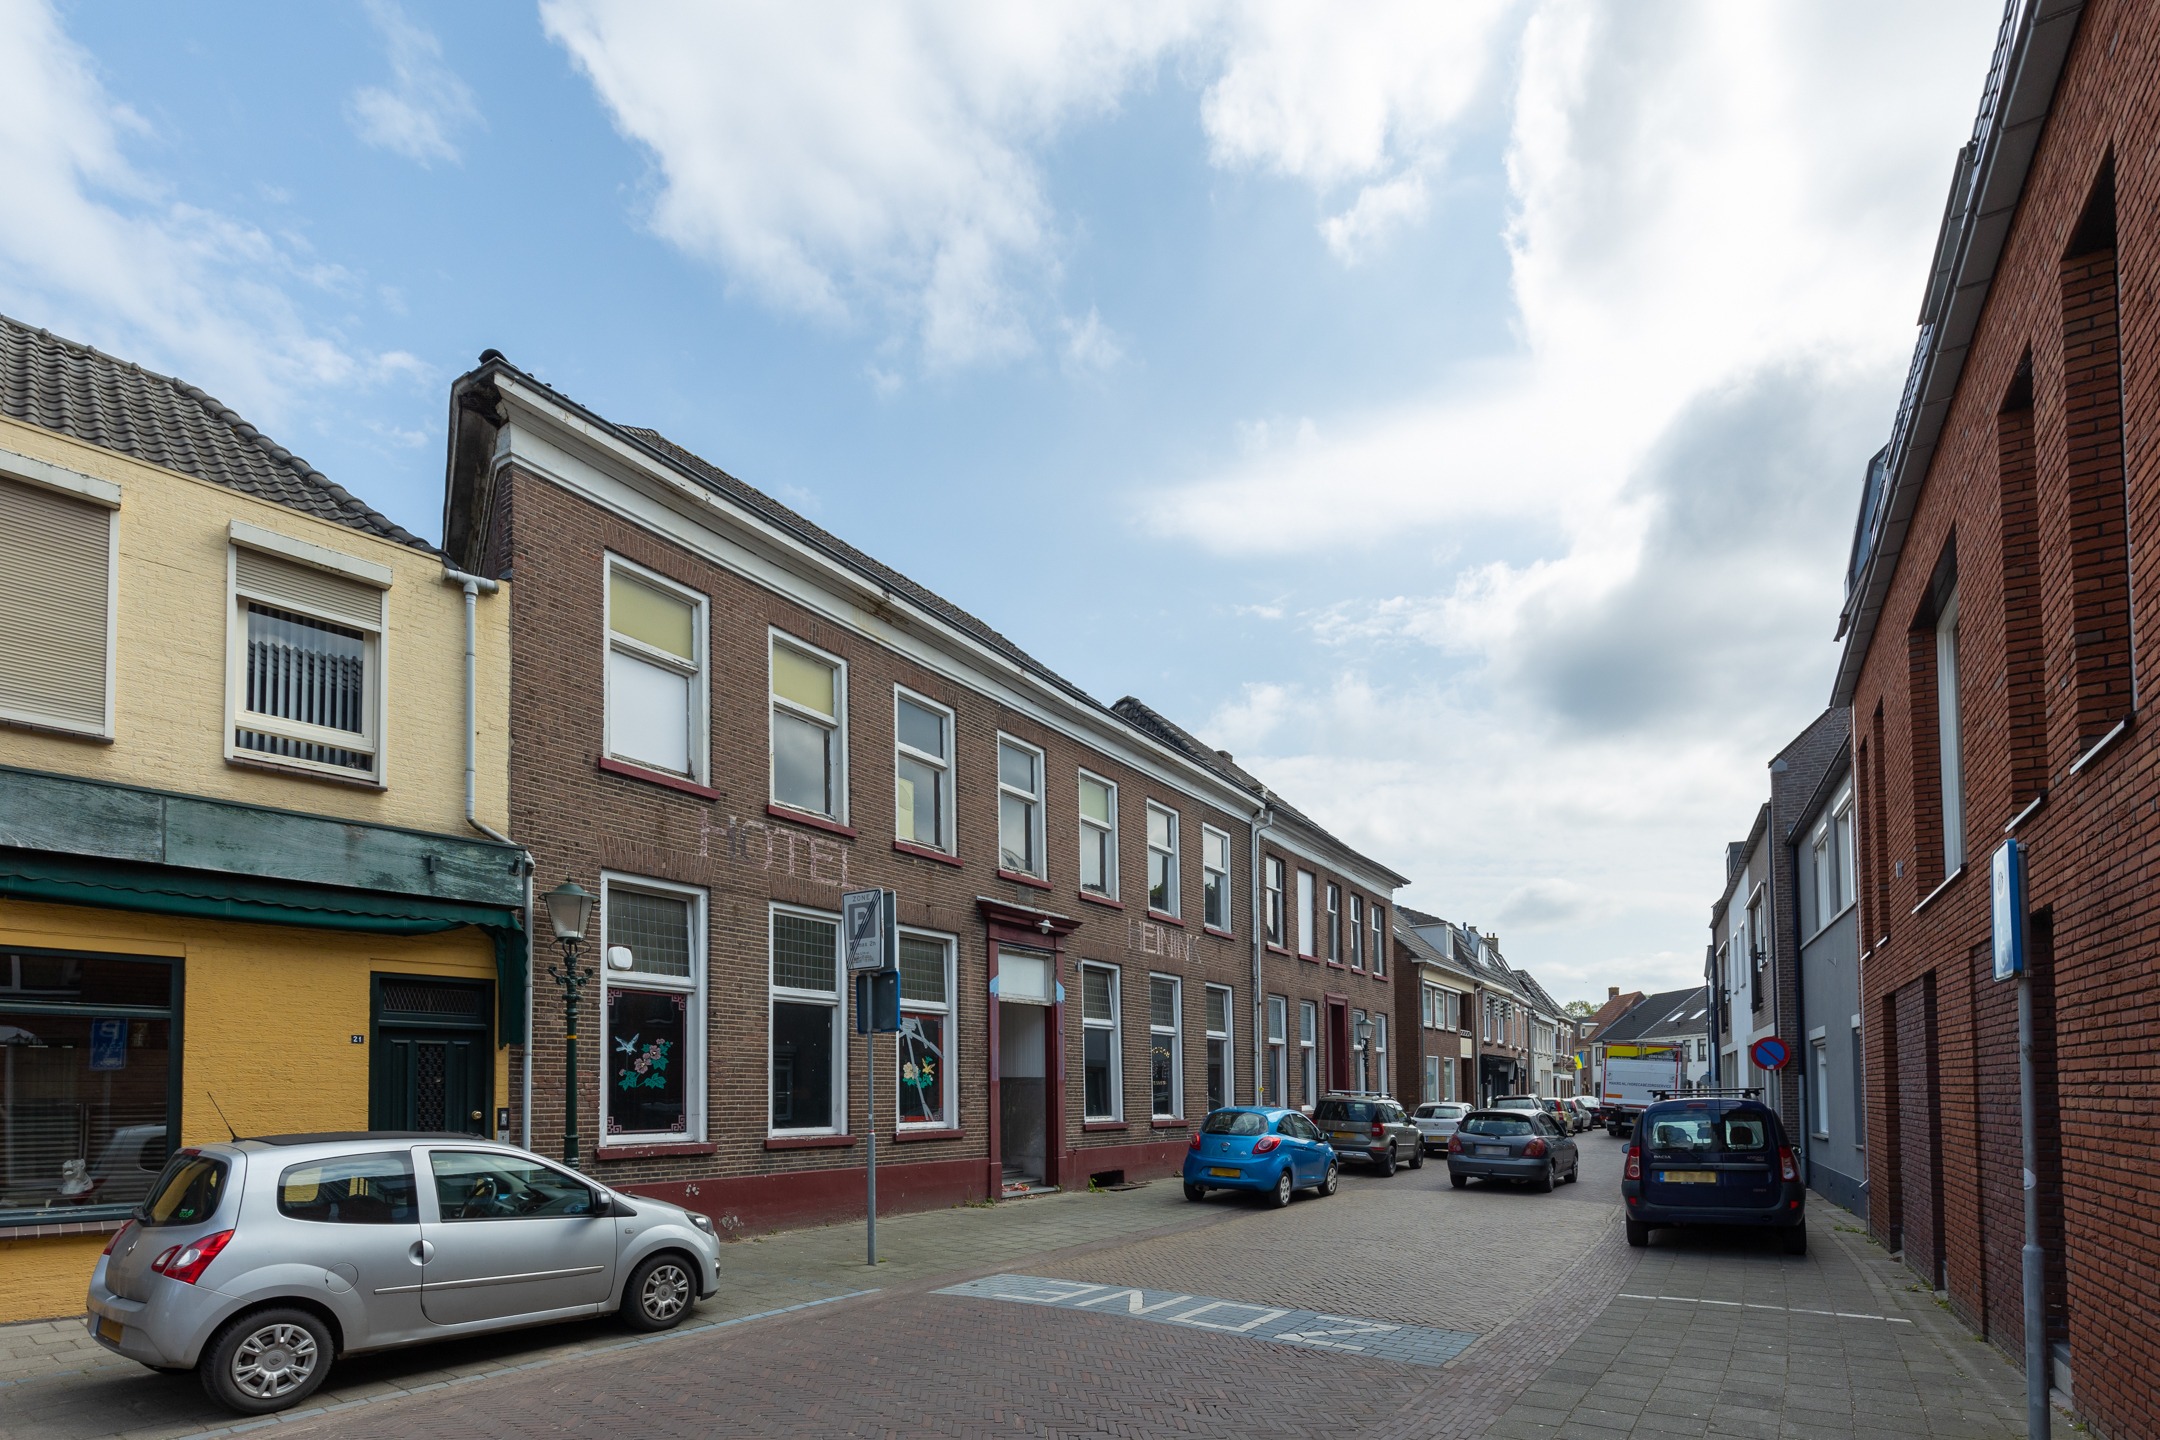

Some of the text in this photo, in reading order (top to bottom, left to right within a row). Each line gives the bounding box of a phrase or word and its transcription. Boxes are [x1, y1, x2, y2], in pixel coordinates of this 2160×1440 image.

[699, 807, 865, 889] HOTEL
[852, 894, 871, 902] ZONE
[854, 906, 868, 936] P
[352, 1035, 362, 1043] 21
[992, 1280, 1402, 1352] ZONE
